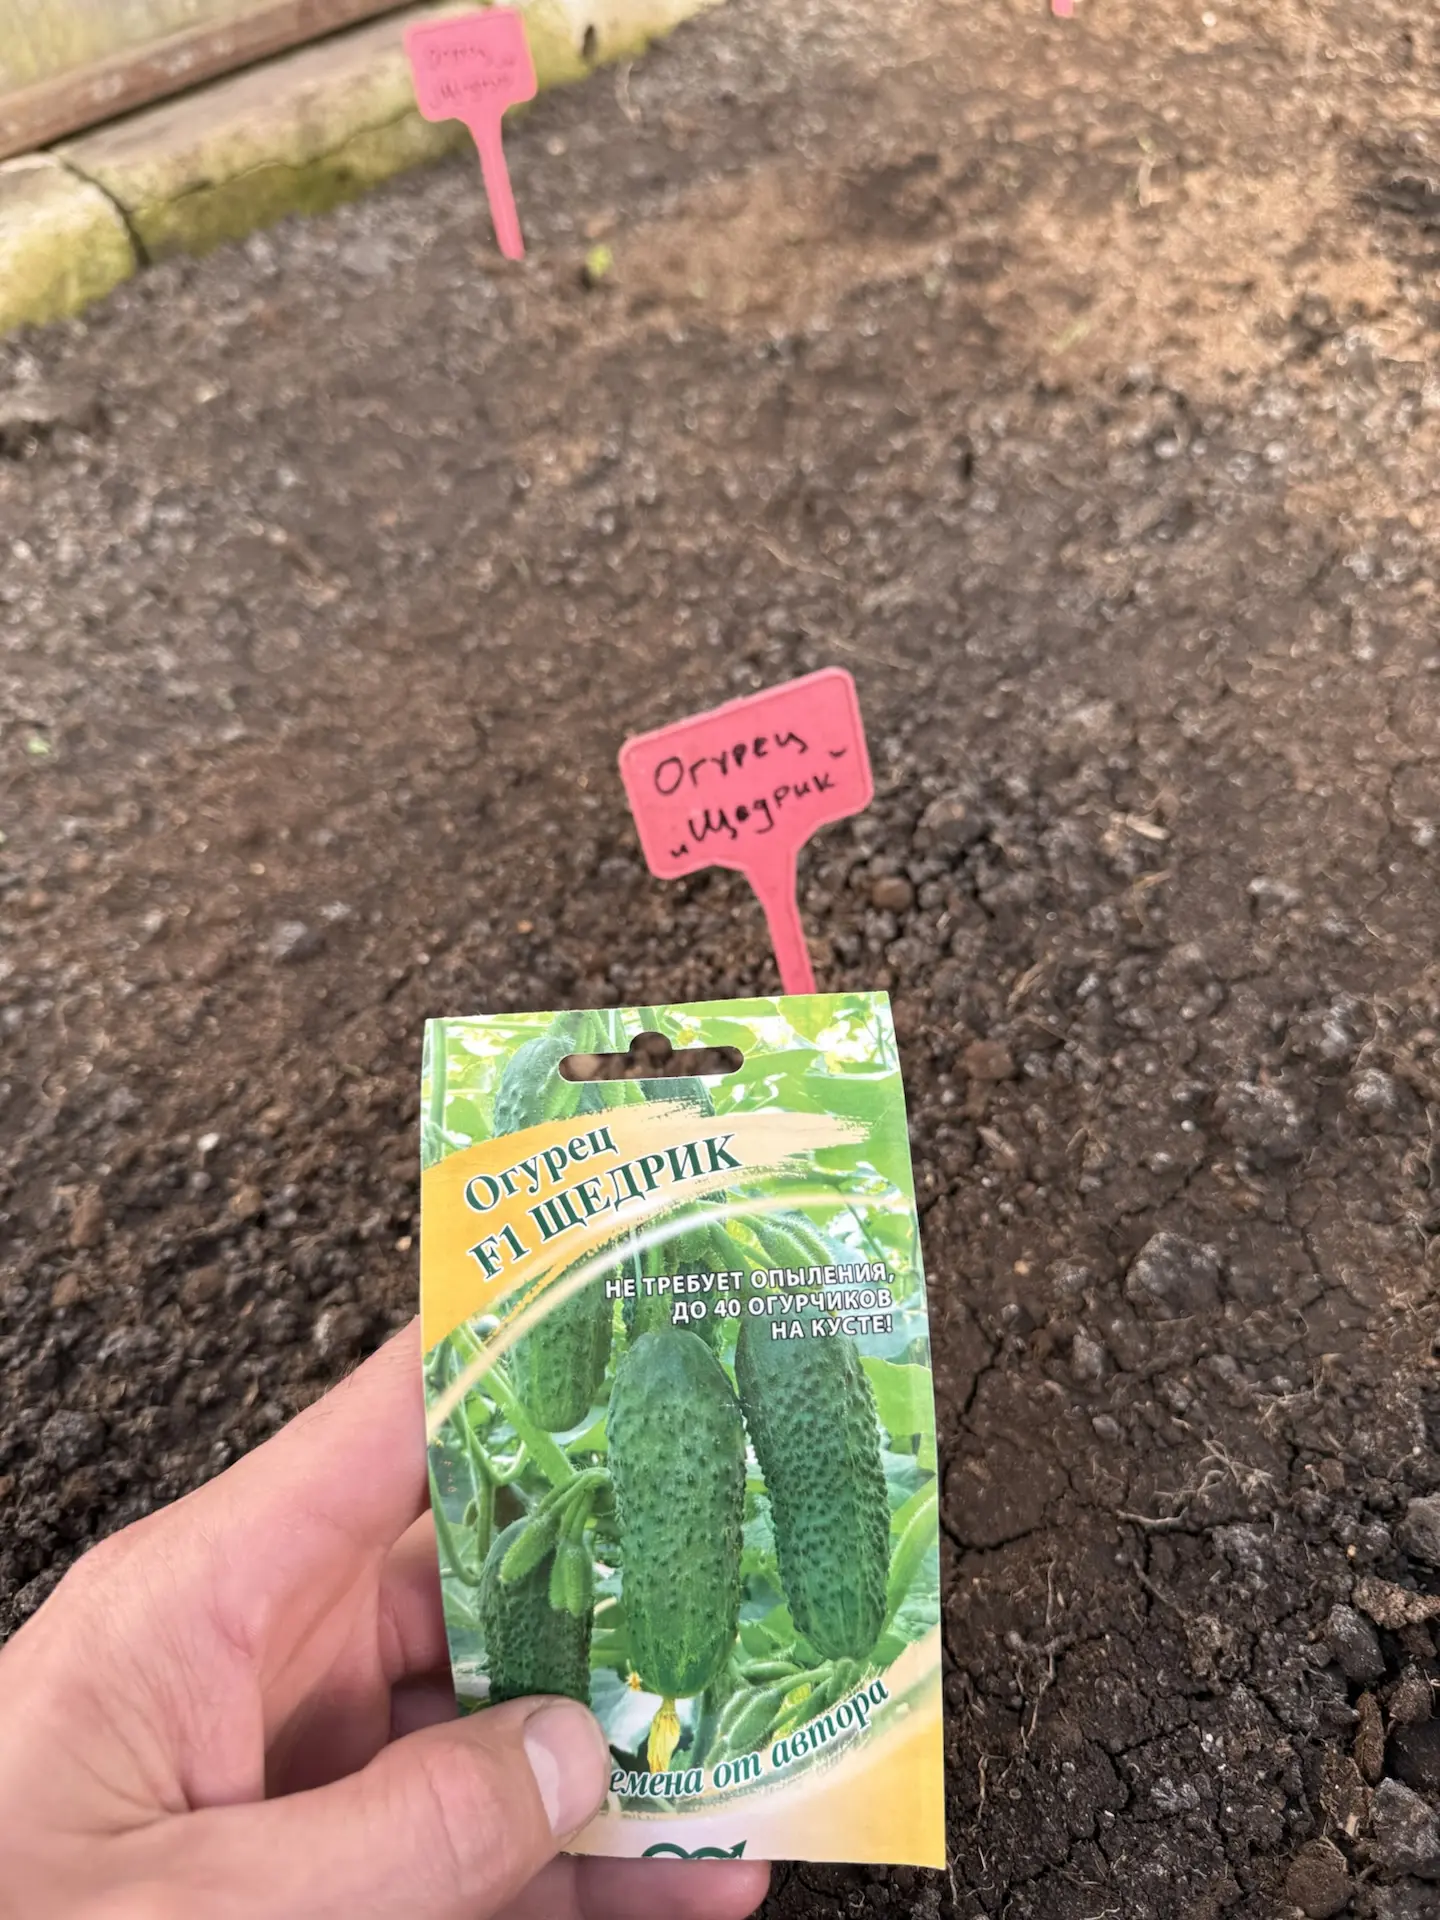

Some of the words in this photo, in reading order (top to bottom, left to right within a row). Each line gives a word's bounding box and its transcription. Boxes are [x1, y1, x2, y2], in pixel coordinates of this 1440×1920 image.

[654, 732, 808, 796] Огурец
[465, 1126, 617, 1211] Огурец
[469, 1225, 530, 1279] F1
[529, 1133, 743, 1242] ЩЕДРИК
[605, 1278, 636, 1298] НЕ
[643, 1272, 743, 1295] ТРЕБУЕТ
[751, 1262, 895, 1288] ОПЫЛЕНИЯ,
[672, 1303, 706, 1324] ДО
[714, 1300, 741, 1317] 40
[748, 1289, 892, 1316] ОГУРЧИКОВ
[771, 1321, 805, 1340] НА
[812, 1315, 892, 1337] КУСТЕ!
[609, 1767, 702, 1796] емена
[713, 1755, 761, 1788] от
[772, 1679, 889, 1766] автора
